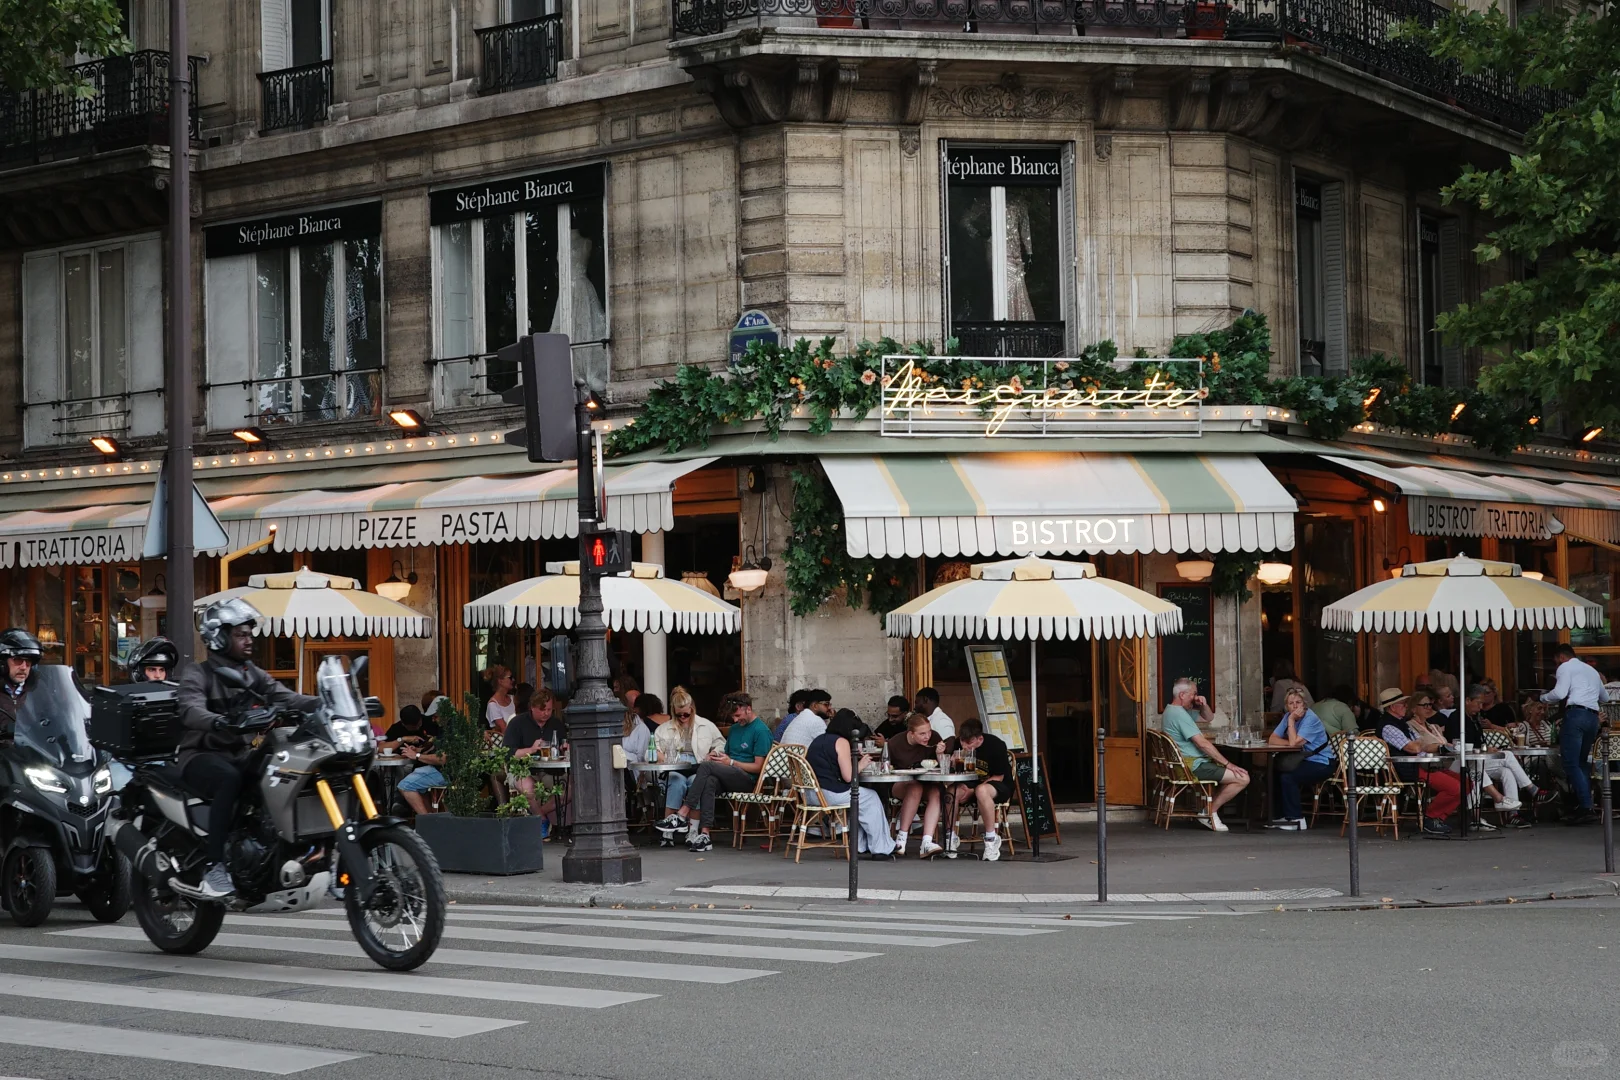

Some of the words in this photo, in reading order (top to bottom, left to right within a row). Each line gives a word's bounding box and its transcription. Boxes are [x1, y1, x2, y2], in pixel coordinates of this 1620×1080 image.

[946, 155, 1005, 180] téphane
[1010, 155, 1060, 175] Bianca
[456, 188, 520, 212] Stéphane
[524, 179, 574, 200] Bianca
[238, 222, 295, 245] Stéphane
[298, 216, 341, 235] Bianca
[884, 359, 1200, 437] Marguerite
[358, 516, 417, 541] PIZZE
[441, 511, 509, 537] PASTA
[1012, 519, 1135, 545] BISTROT
[1427, 504, 1477, 530] BISTROT
[1487, 508, 1547, 534] TRATTORIA
[26, 534, 126, 560] TRATTORIA
